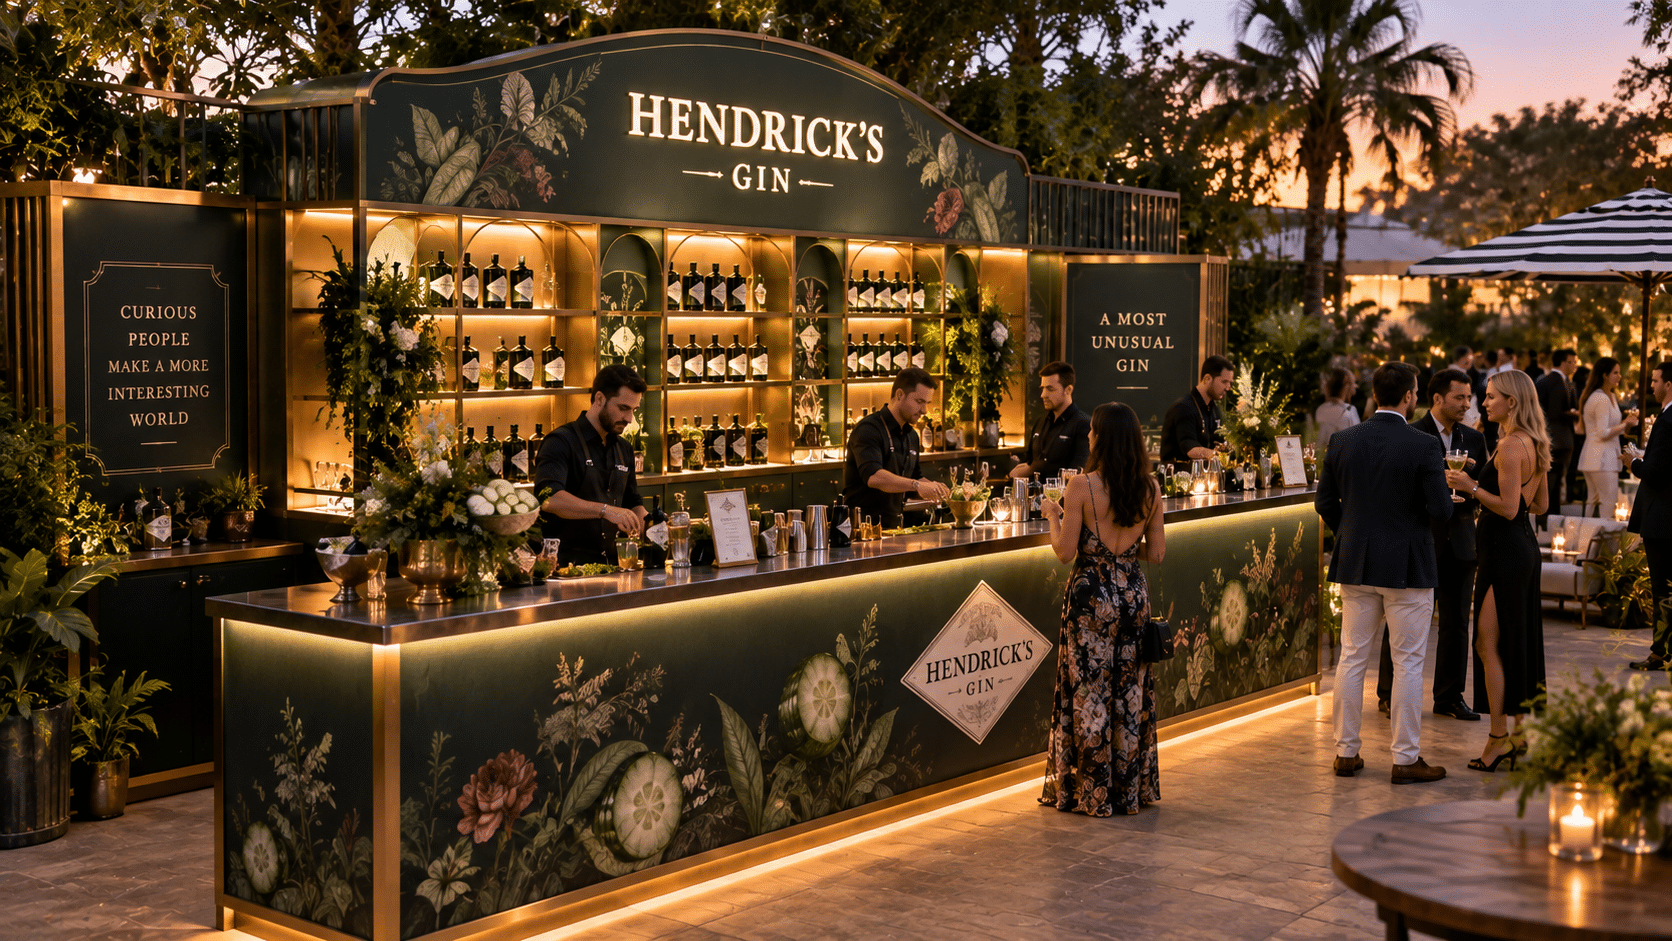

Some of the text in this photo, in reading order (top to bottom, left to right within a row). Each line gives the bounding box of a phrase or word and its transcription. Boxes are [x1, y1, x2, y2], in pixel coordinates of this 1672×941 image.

[628, 91, 884, 164] HENDRICK'S
[732, 163, 791, 194] GIN
[121, 305, 197, 320] CURIOUS
[1099, 312, 1167, 326] A MOST
[128, 332, 190, 347] PEOPLE
[1091, 335, 1175, 349] UNUSUAL
[108, 359, 209, 373] MAKE A MORE
[1116, 359, 1150, 372] GIN
[108, 385, 210, 401] INTERESTING
[129, 411, 189, 427] WORLD
[925, 639, 1034, 684] HENDRICK'S
[966, 677, 995, 697] GIN
